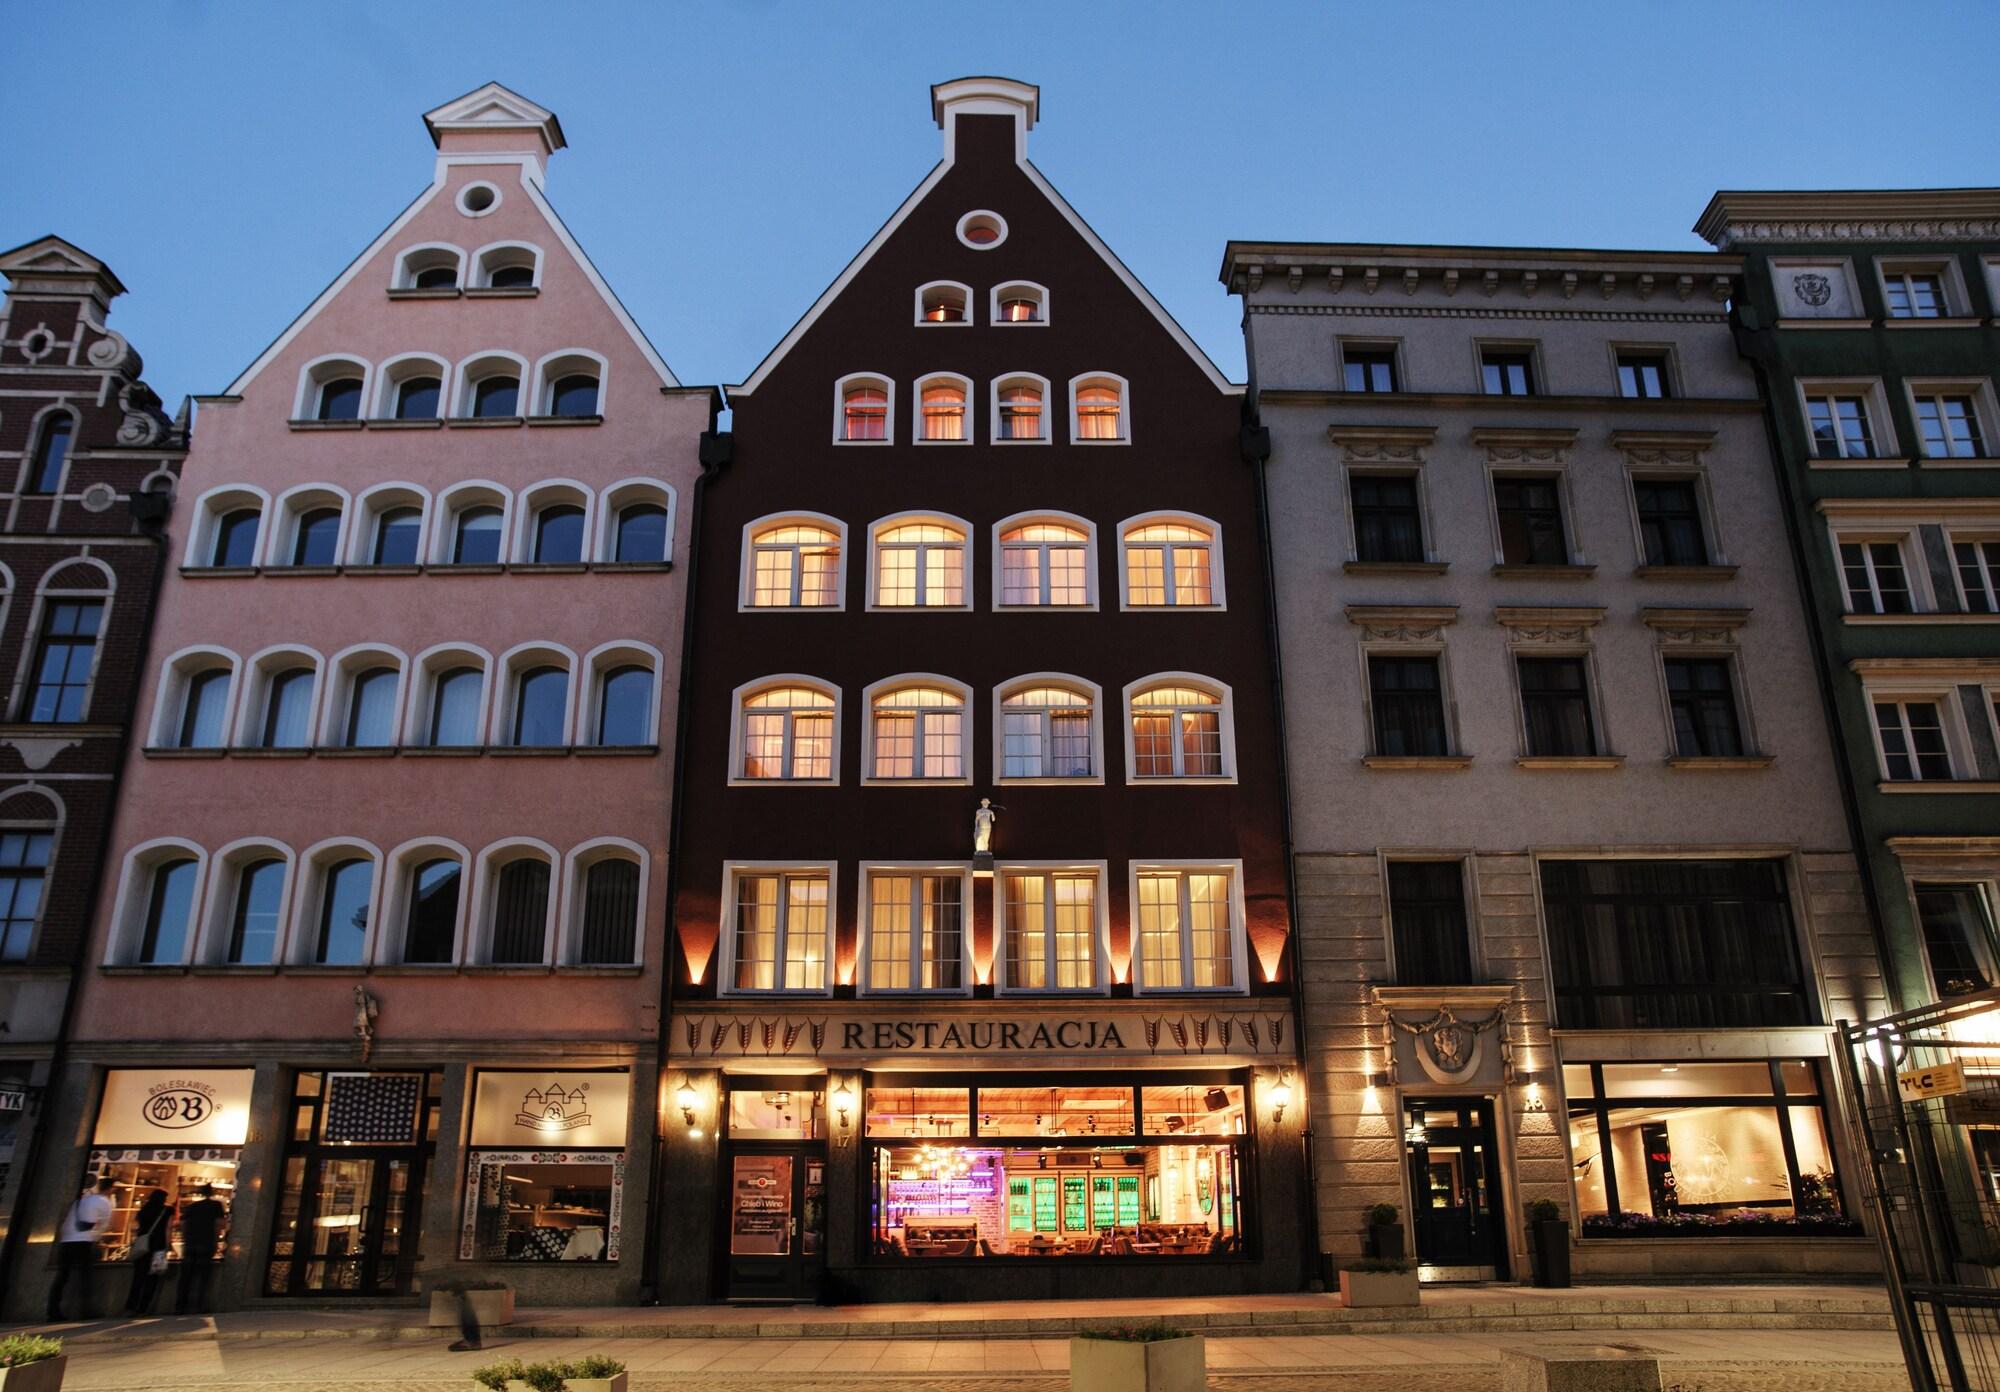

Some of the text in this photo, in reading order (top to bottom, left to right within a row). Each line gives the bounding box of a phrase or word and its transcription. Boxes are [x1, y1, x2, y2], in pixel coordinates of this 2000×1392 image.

[841, 1020, 1127, 1049] RESTAURACJA
[148, 1079, 217, 1097] BOLESŁAWIEC
[1900, 1074, 1934, 1092] TLC
